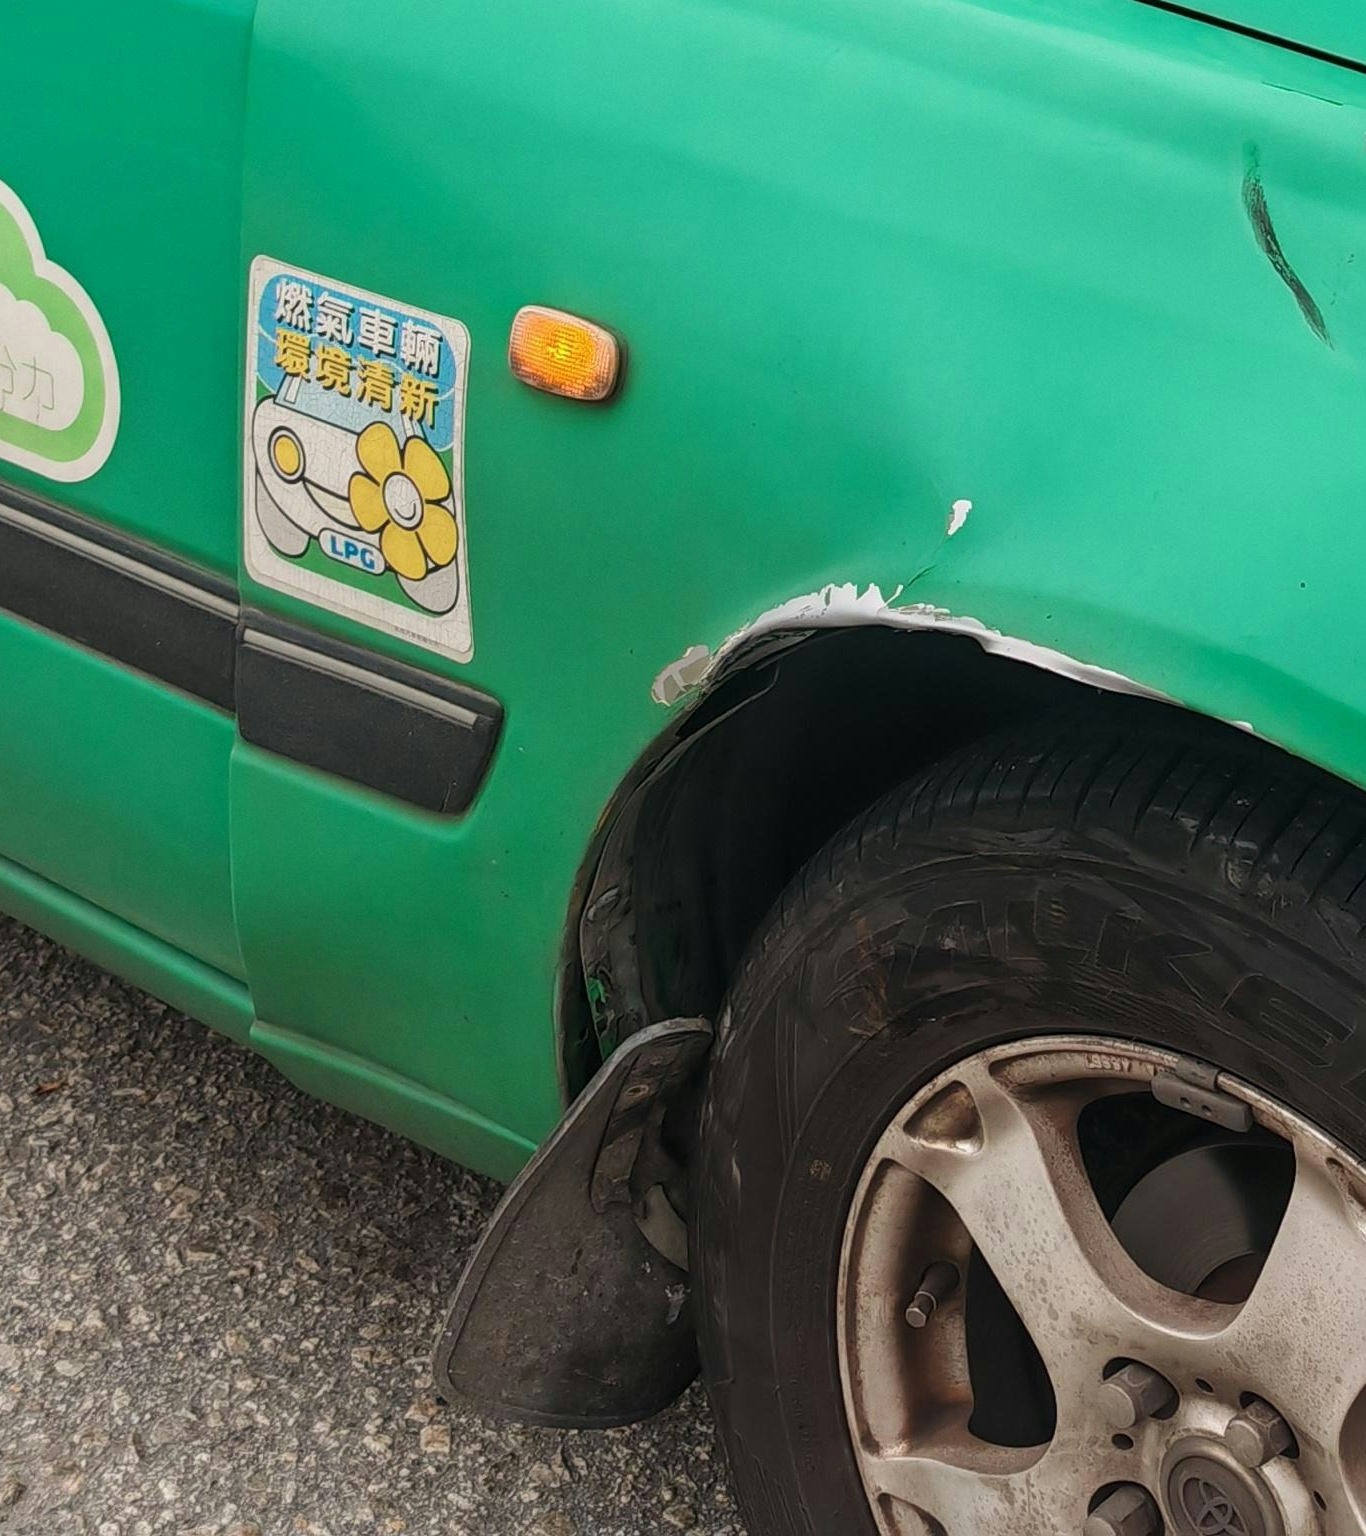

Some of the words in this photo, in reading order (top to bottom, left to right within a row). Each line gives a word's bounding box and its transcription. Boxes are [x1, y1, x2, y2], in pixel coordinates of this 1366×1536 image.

[273, 326, 439, 430] 環境清新
[275, 277, 443, 380] 燃氣車輛
[329, 534, 376, 571] LPG
